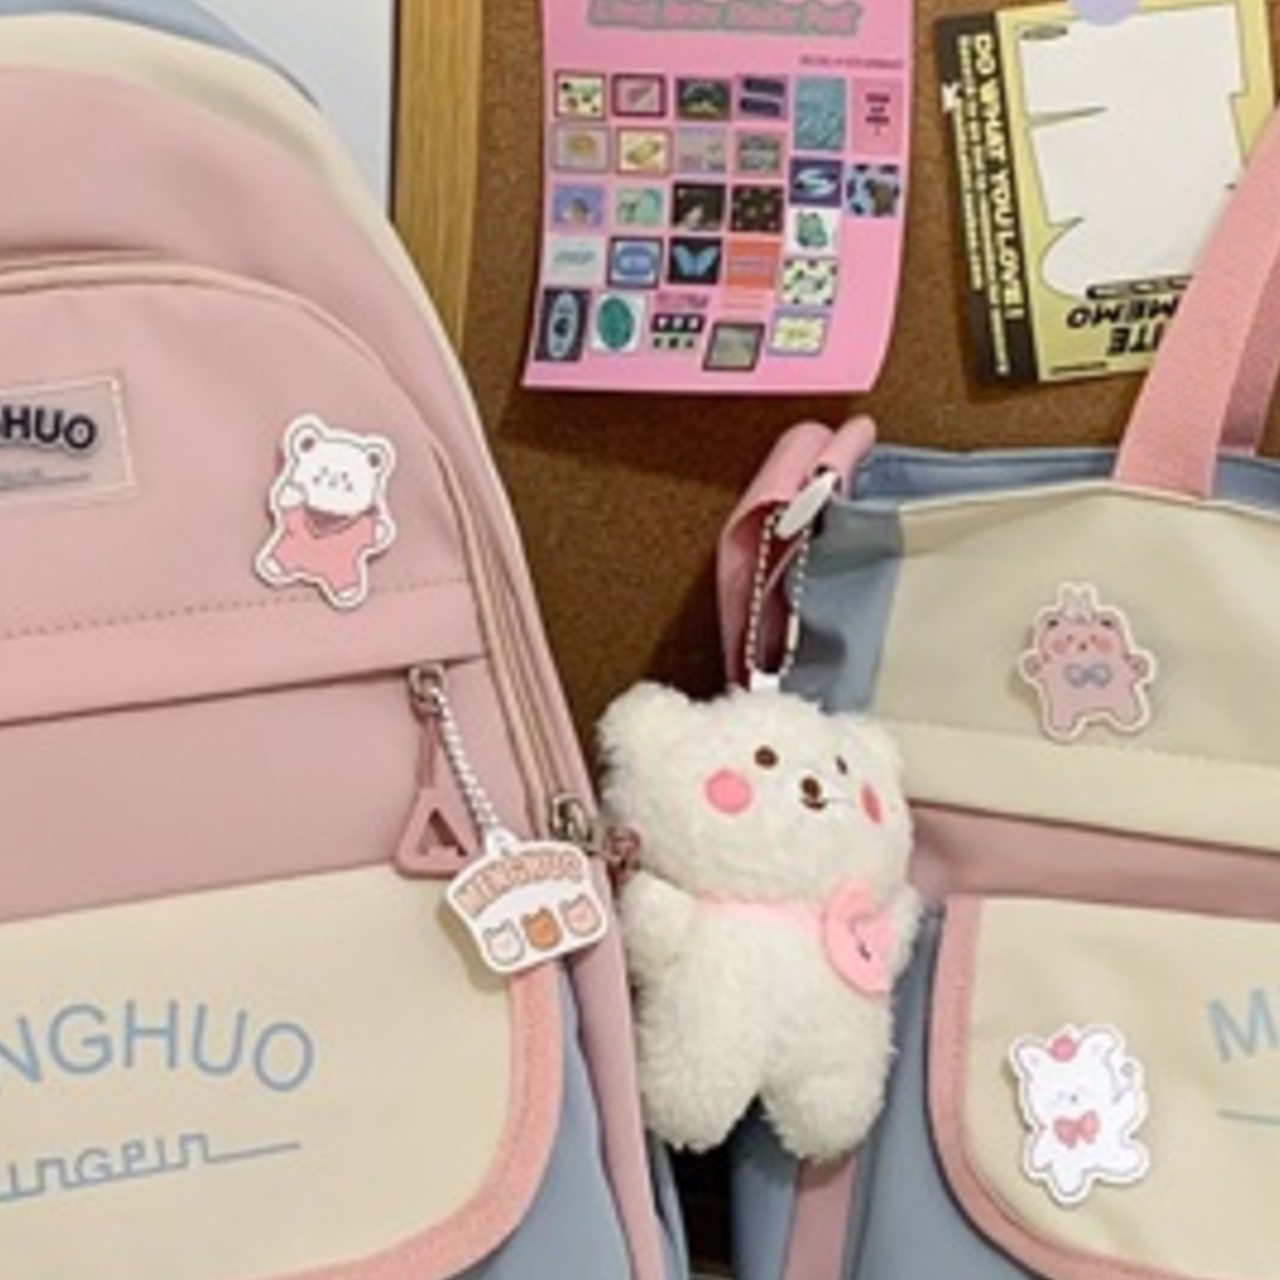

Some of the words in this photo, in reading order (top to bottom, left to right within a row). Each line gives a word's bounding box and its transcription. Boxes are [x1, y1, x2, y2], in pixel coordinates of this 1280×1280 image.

[973, 32, 995, 75] DO
[980, 77, 1007, 166] WHAT
[990, 166, 1017, 231] YOU
